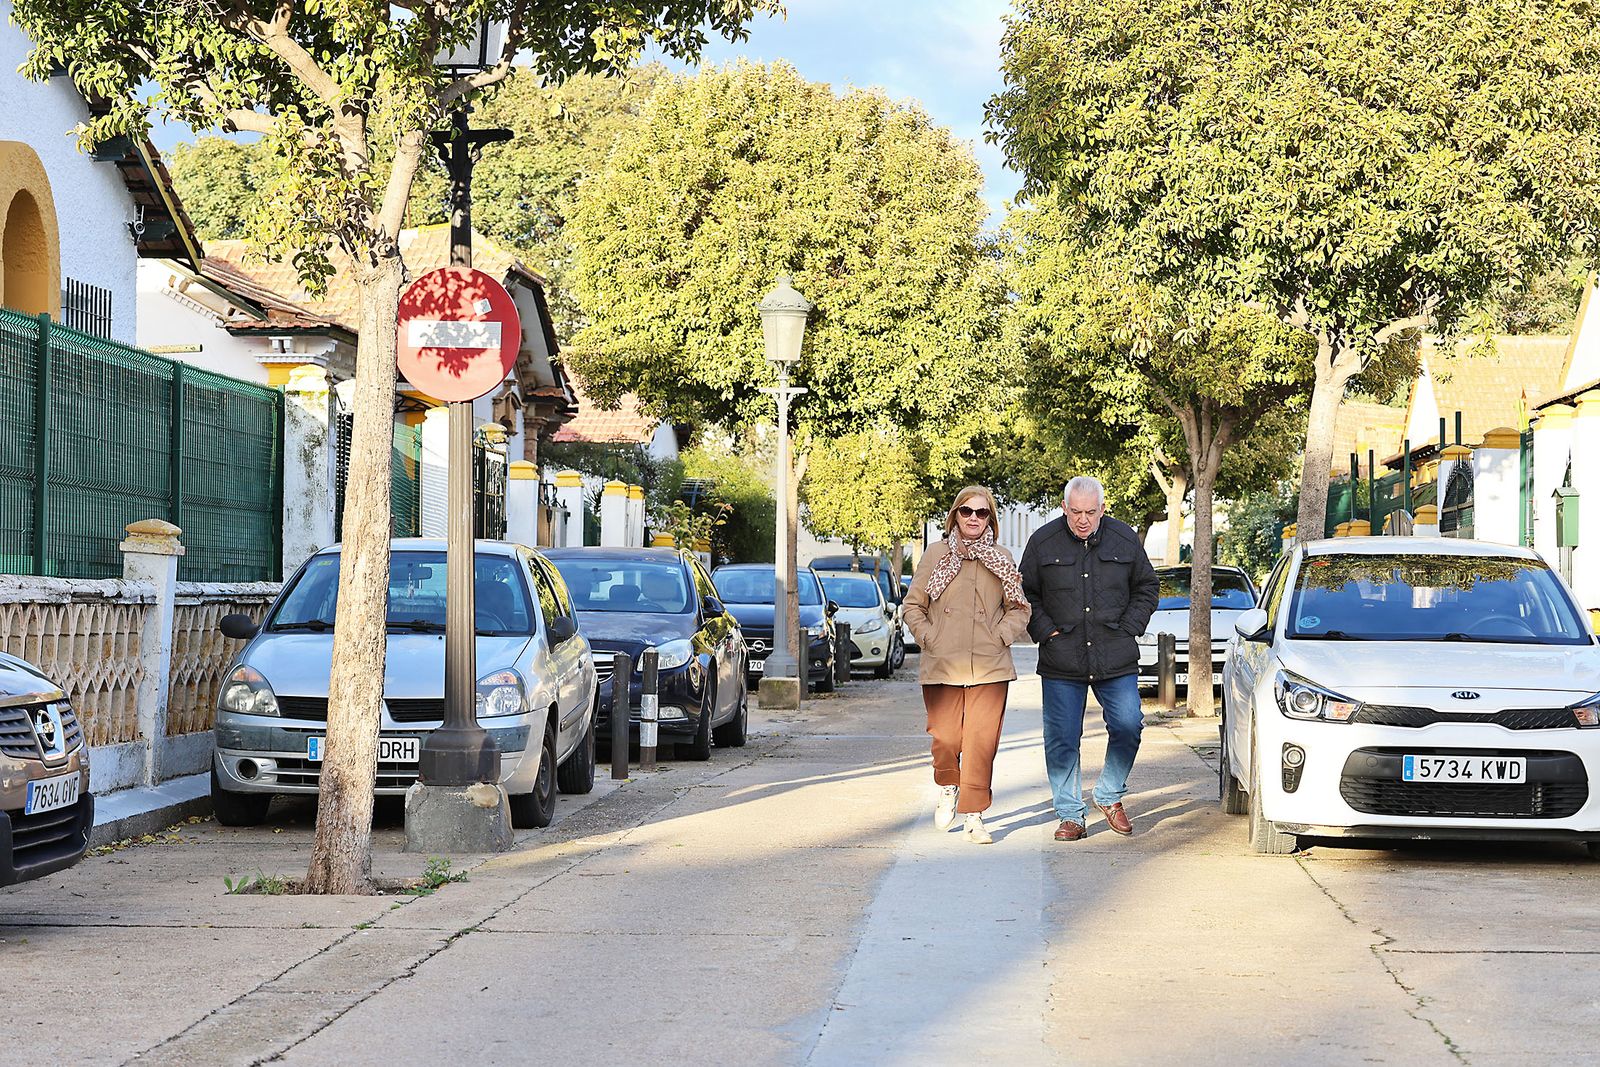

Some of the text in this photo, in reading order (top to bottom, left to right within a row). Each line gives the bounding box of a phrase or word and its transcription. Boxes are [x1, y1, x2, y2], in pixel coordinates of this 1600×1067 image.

[1454, 690, 1477, 698] KIA
[380, 741, 415, 759] DRH
[1420, 759, 1521, 780] 5734 KWD
[33, 776, 79, 810] 7634 GVF
